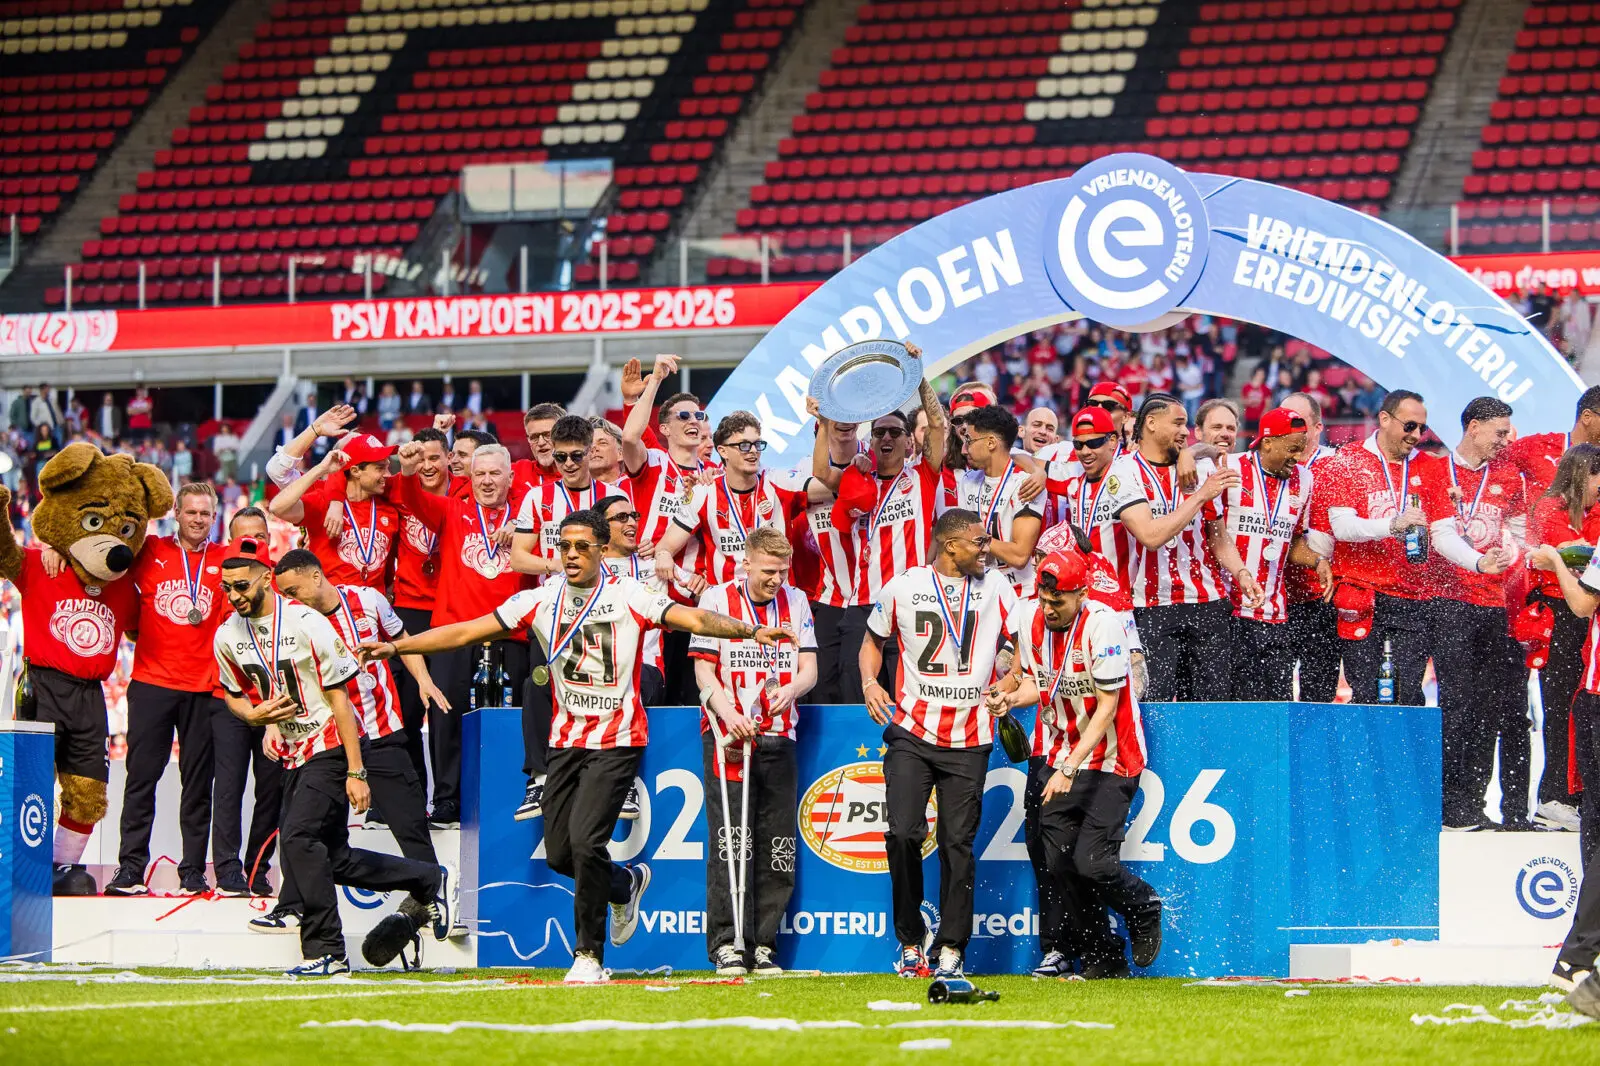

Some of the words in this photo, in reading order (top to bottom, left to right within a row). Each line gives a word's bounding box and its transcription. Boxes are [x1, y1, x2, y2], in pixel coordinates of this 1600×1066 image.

[1081, 168, 1194, 284] VRIENDENLOTERIJ
[332, 303, 388, 340] PSV
[395, 295, 554, 338] KAMPIOEN
[561, 288, 736, 331] 2025-2026
[1233, 249, 1422, 359] EREDIVISIE
[1246, 213, 1534, 404] VRIENDENLOTERIJ
[1240, 515, 1295, 530] BRAIPORT
[55, 598, 116, 625] KAMPIOE
[75, 624, 95, 644] 27
[915, 610, 979, 677] 27
[560, 621, 618, 687] 27
[730, 660, 792, 669] EINDHOEN
[564, 692, 623, 710] KAMPIOE
[919, 683, 982, 700] KAMPIOEN
[855, 860, 871, 868] EST
[1526, 856, 1578, 909] VRIENDENLOTERIJ
